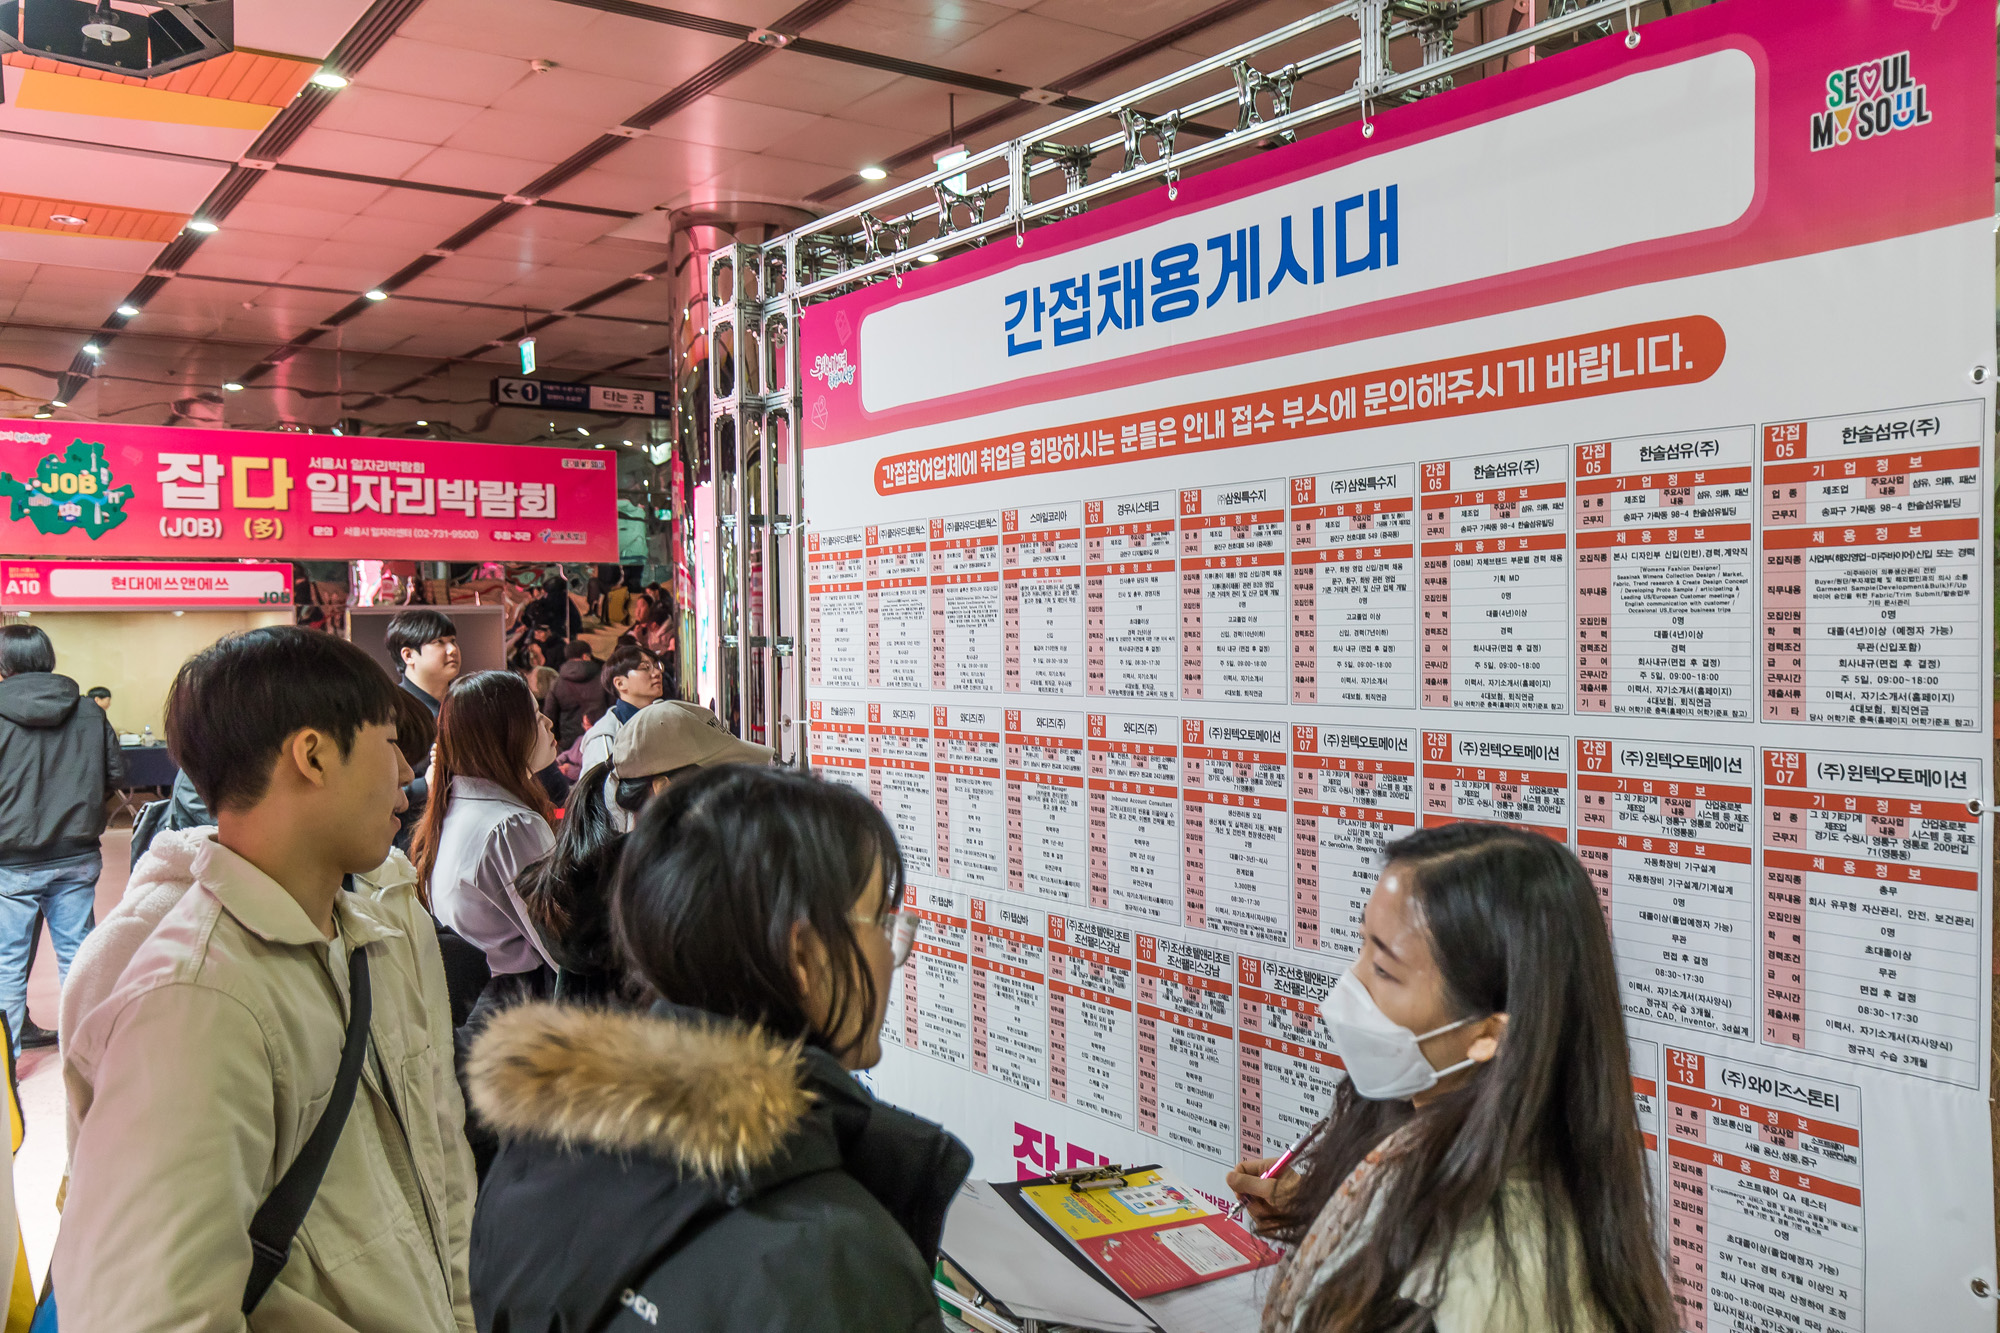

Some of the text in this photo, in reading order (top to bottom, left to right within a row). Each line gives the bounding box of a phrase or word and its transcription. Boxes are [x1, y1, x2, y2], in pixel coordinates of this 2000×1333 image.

[1004, 183, 1399, 357] 간접채용게시대
[602, 390, 628, 403] 타는
[632, 393, 645, 404] 곳
[881, 332, 1694, 489] 간접참여업체에 취업을 희망하시는 분들은 안내 접수 부스에 문의해주시기 바랍니다.
[1771, 424, 1800, 442] 간접
[1842, 416, 1940, 445] 한솔섬유(주)
[1581, 443, 1606, 460] 간접
[1639, 439, 1719, 462] 한솔섬유(주)
[1776, 443, 1795, 458] 05
[308, 457, 425, 474] 서울시 일자리박람회
[1425, 463, 1446, 477] 간접
[1474, 458, 1540, 480] 한솔섬유(주)
[1586, 461, 1601, 474] 05
[41, 472, 98, 495] JOB
[1294, 478, 1312, 491] 간접
[1330, 474, 1397, 494] (주)삼원특수지
[1429, 478, 1442, 490] 05
[1871, 475, 1904, 486] 주요사업
[306, 472, 558, 520] 일자리박람회
[1822, 484, 1849, 495] 제조업
[1297, 491, 1309, 503] 04
[1087, 501, 1101, 513] 간접
[1117, 500, 1160, 516] 경우시스테크
[1821, 507, 1847, 517] 송파구
[1880, 503, 1902, 512] 98-4
[1907, 498, 1962, 511] 한솔섬유빌딩
[1004, 511, 1016, 521] 간접
[1030, 510, 1068, 524] 스마일코리아
[1090, 513, 1099, 523] 03
[1771, 509, 1797, 520] 근무지
[159, 516, 223, 538] (JOB)
[931, 519, 942, 529] 간접
[1006, 522, 1014, 531] 02
[6, 580, 40, 595] A10
[1827, 625, 1953, 636] 대졸(4년)이상 (예정자 가능)
[1856, 642, 1922, 652] 무관(신입포함)
[1838, 658, 1941, 669] 회사내규(면접 후 결정)
[1767, 673, 1801, 683] 근무시간
[1840, 674, 1850, 684] 주
[1877, 675, 1939, 685] 09:00~18:00
[1861, 691, 1955, 703] 자기소개서(홈페이지)
[870, 704, 879, 713] 간접
[935, 707, 945, 716] 간접
[1891, 706, 1929, 716] 퇴직연금
[937, 717, 944, 725] 06
[1007, 710, 1019, 721] 간접
[1090, 715, 1103, 726] 간접
[1009, 721, 1017, 730] 06
[1036, 717, 1066, 730] 와디즈(주)
[1123, 721, 1158, 735] 와디즈(주)
[1185, 720, 1201, 732] 간접
[1092, 726, 1101, 736] 06
[1188, 732, 1198, 743] 07
[1208, 726, 1281, 743] (주)윈텍오토메이션
[1296, 726, 1314, 739] 간접
[1299, 739, 1311, 751] 07
[1323, 732, 1408, 752] (주)윈텍오토메이션
[1426, 733, 1447, 746] 간접
[1430, 747, 1444, 760] 07
[1459, 740, 1559, 761] (주)윈텍오토메이션
[1582, 741, 1606, 756] 간접
[1587, 757, 1602, 770] 07
[1620, 749, 1742, 774] (주)윈텍오토메이션
[1770, 752, 1799, 769] 간접
[1776, 770, 1794, 784] 07
[1817, 762, 1967, 789] (주)윈텍오토메이션
[975, 911, 982, 919] 09
[1051, 917, 1063, 928] 간접
[1053, 929, 1061, 938] 10
[1139, 936, 1153, 948] 간접
[1142, 950, 1151, 959] 10
[1242, 958, 1257, 973] 간접
[1245, 972, 1255, 984] 10
[1655, 968, 1704, 984] 08:30~17:30
[1857, 1006, 1919, 1023] 08:30~17:30
[1672, 1050, 1698, 1070] 간접
[1678, 1070, 1694, 1084] 13
[1721, 1068, 1840, 1112] (주)와이즈스톤티
[1719, 1251, 1733, 1262] SW
